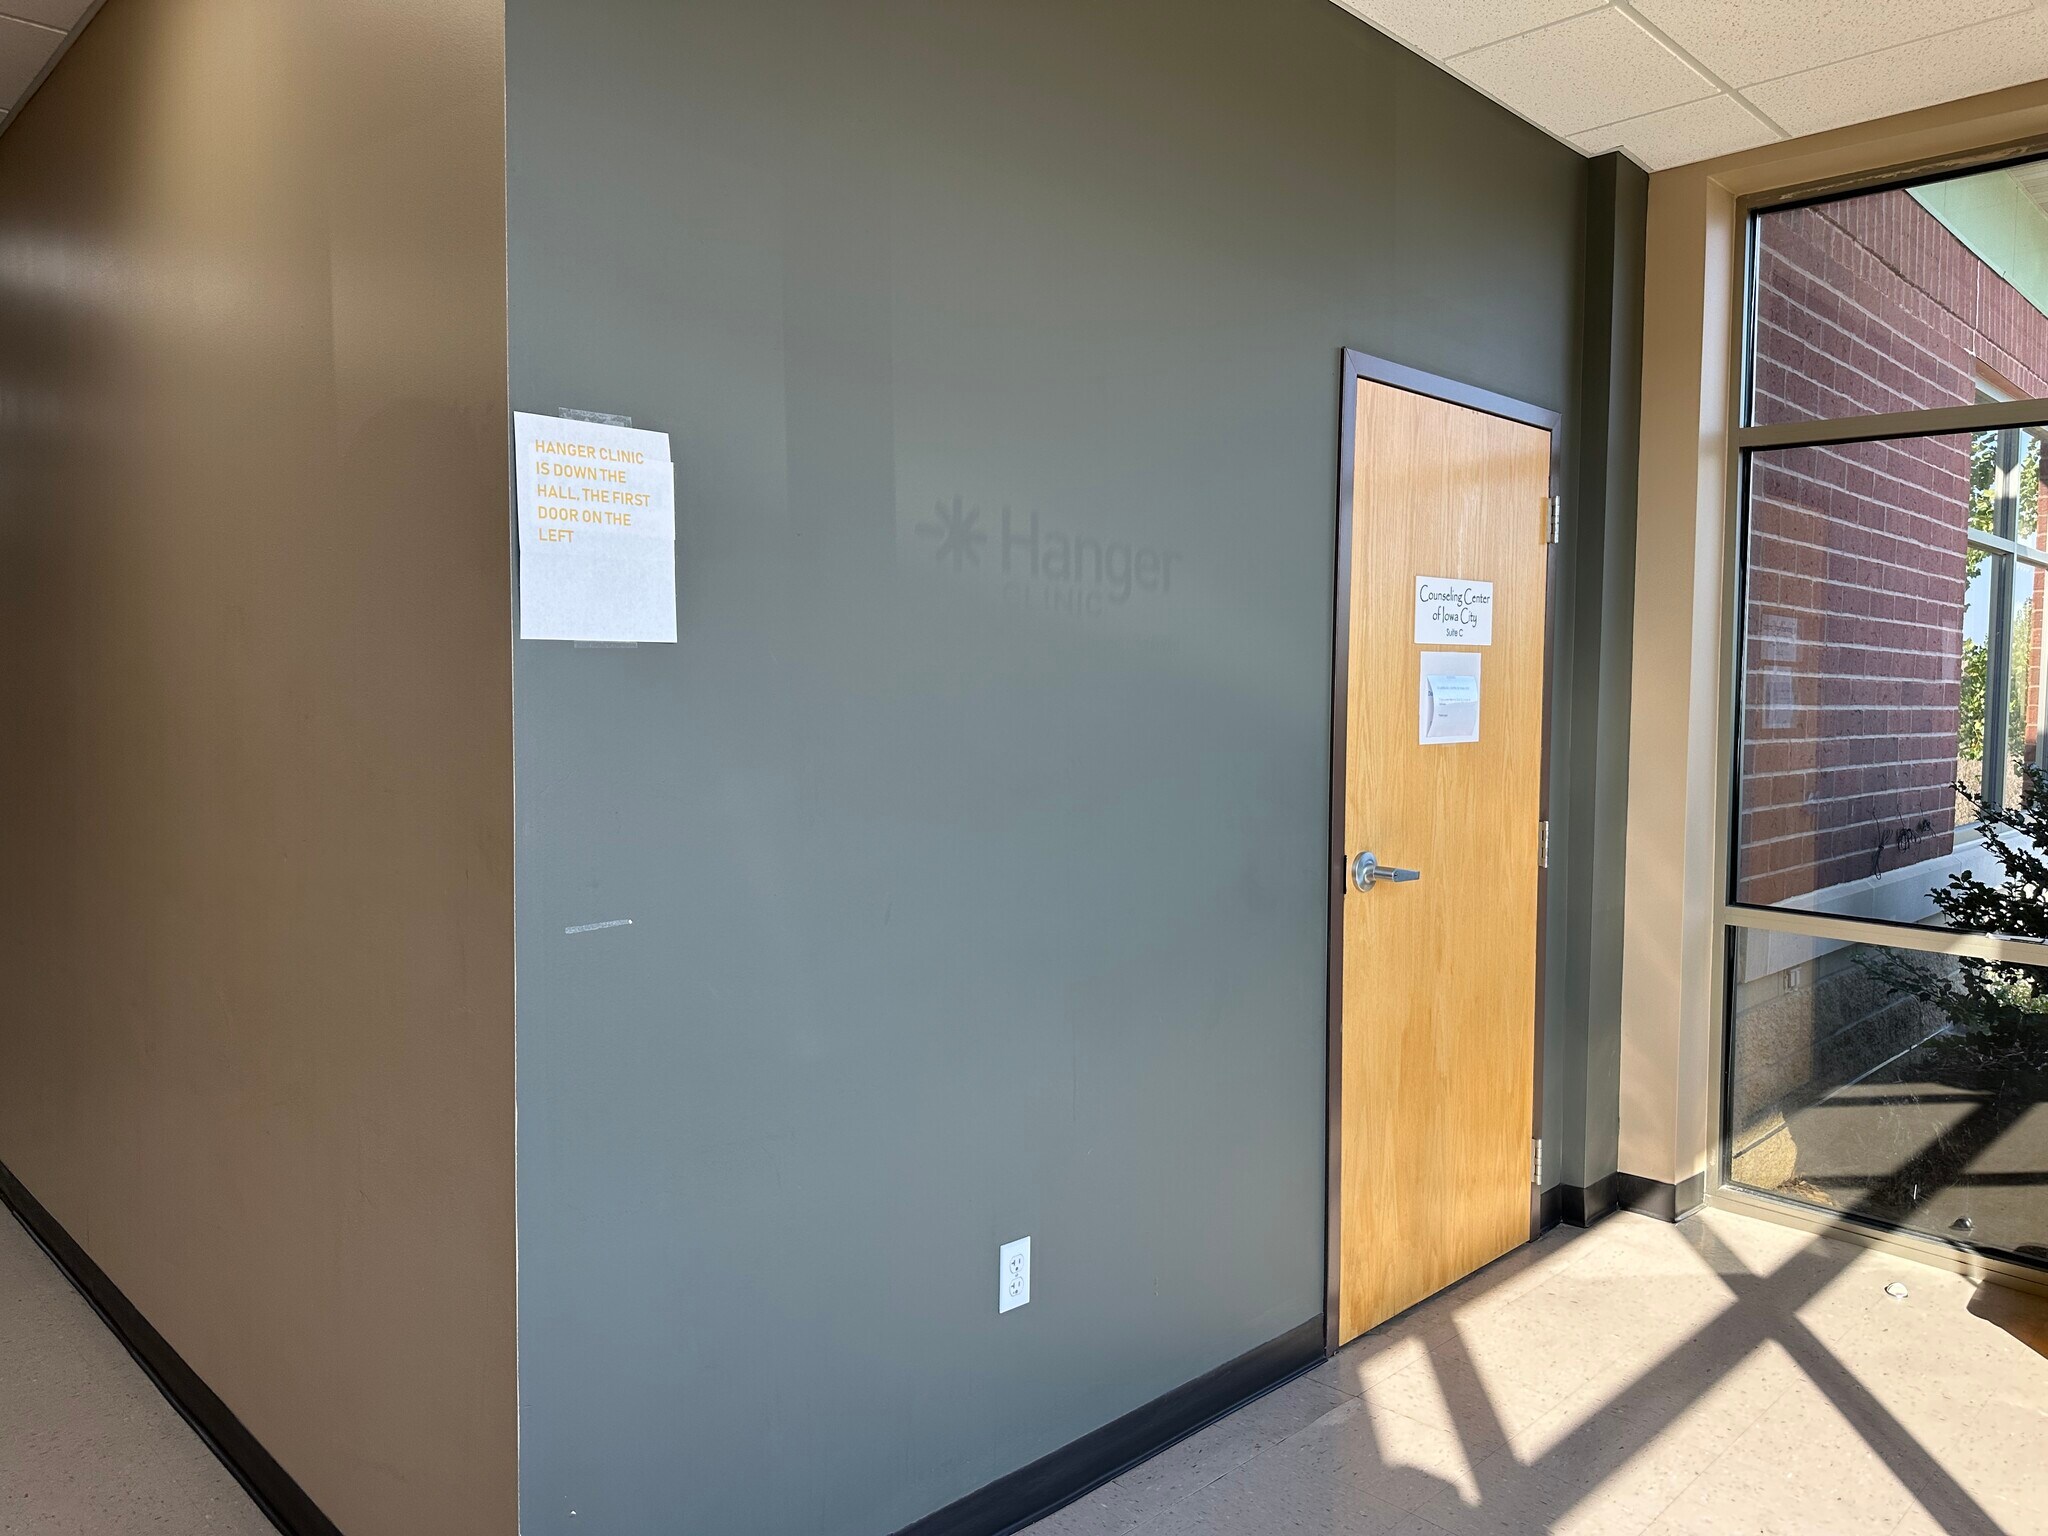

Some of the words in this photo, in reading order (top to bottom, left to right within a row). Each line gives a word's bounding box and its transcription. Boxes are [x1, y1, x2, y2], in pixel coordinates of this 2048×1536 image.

[535, 439, 596, 459] HANGER
[600, 448, 644, 465] CLINIC
[536, 461, 550, 475] IS
[554, 463, 597, 481] DOWN
[600, 468, 627, 483] THE
[582, 488, 610, 503] THE
[612, 491, 650, 507] FIRST
[538, 506, 579, 522] DOOR
[582, 510, 602, 524] ON
[605, 511, 631, 526] THE
[538, 528, 574, 543] LEFT
[1001, 504, 1184, 605] Hanger
[1419, 584, 1463, 607] Counseling
[1463, 588, 1490, 605] Center
[1432, 605, 1441, 621] of
[1442, 606, 1459, 623] Iowa
[1460, 607, 1477, 628] City
